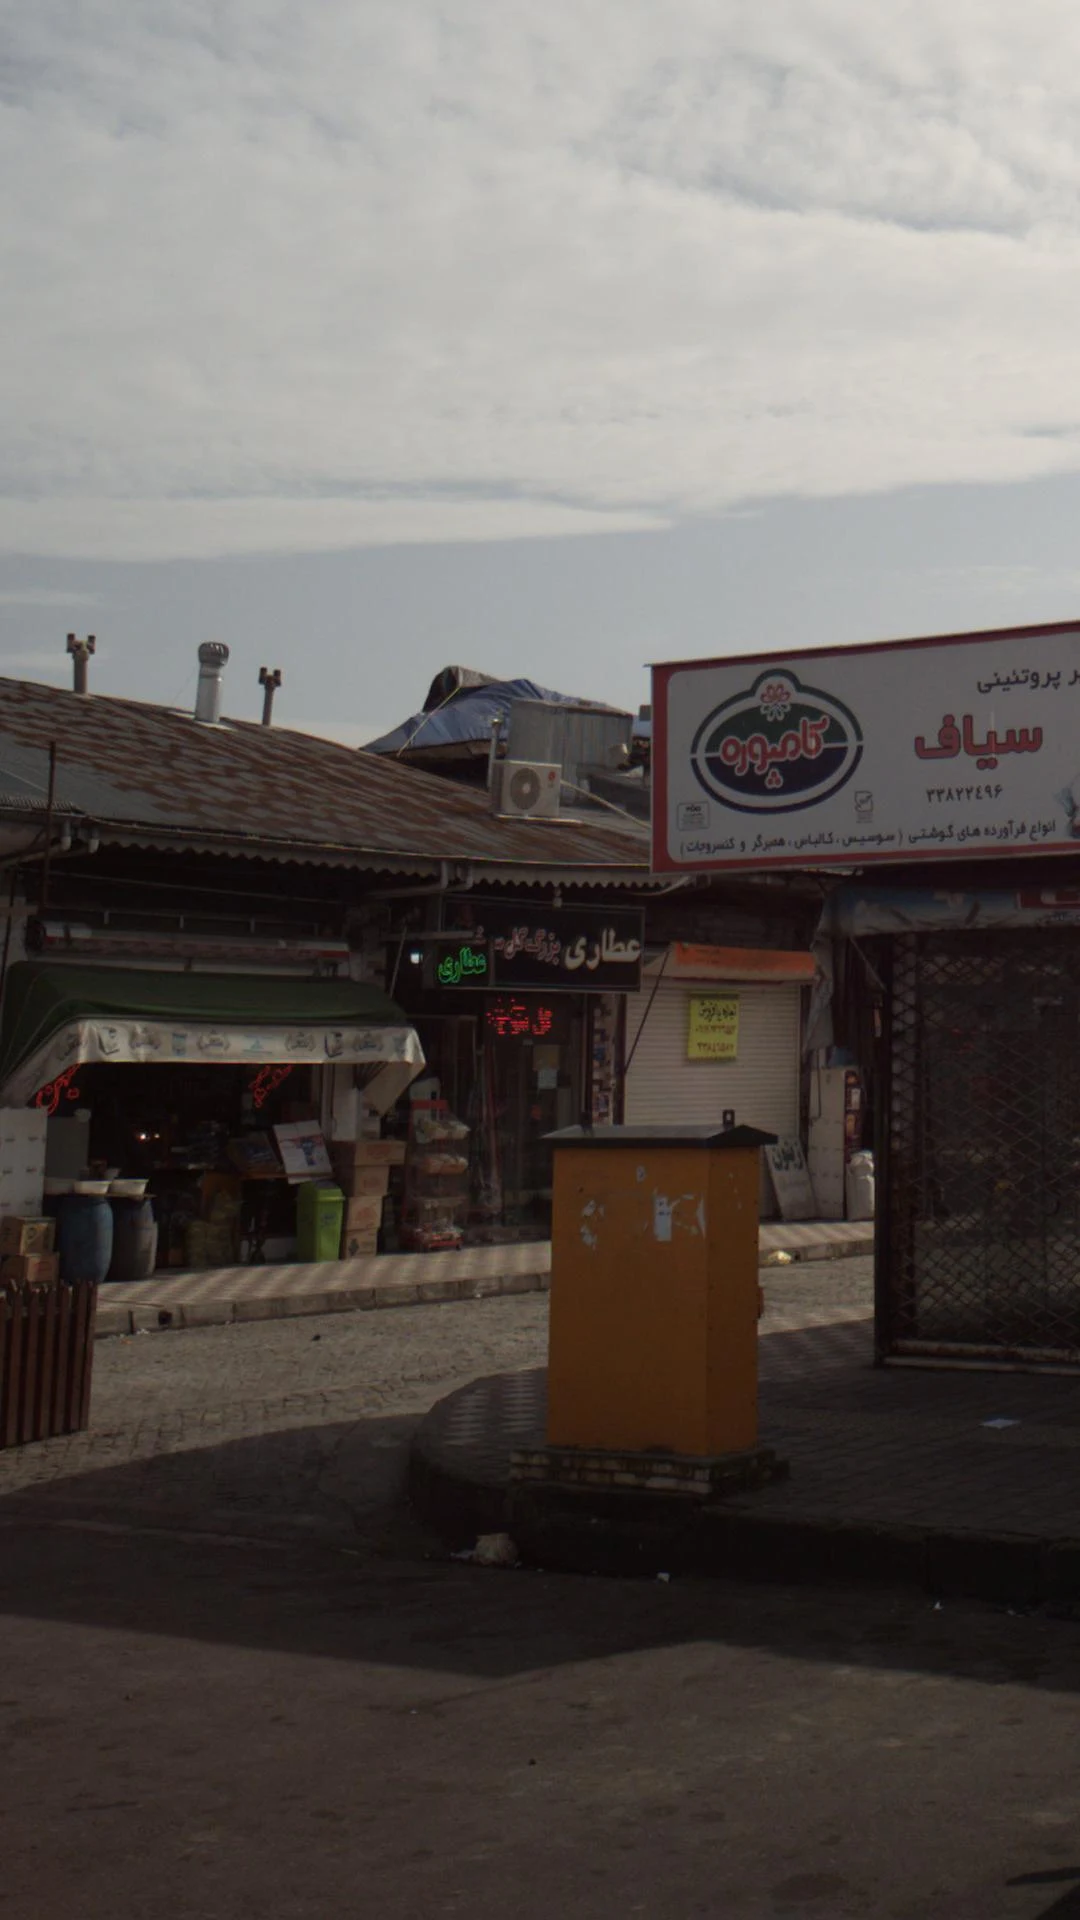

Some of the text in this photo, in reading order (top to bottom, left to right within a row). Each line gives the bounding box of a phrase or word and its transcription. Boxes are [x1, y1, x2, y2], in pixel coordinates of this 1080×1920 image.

[976, 668, 1061, 694] پروتئینی
[914, 713, 1043, 770] سیاف
[908, 822, 954, 844] گوشتی
[957, 824, 981, 841] های
[984, 820, 1027, 840] فرآورده
[1029, 819, 1056, 842] انواع
[739, 840, 746, 852] و
[752, 834, 786, 852] همبرگر
[564, 928, 641, 970] عطاری
[438, 946, 487, 984] عطاری
